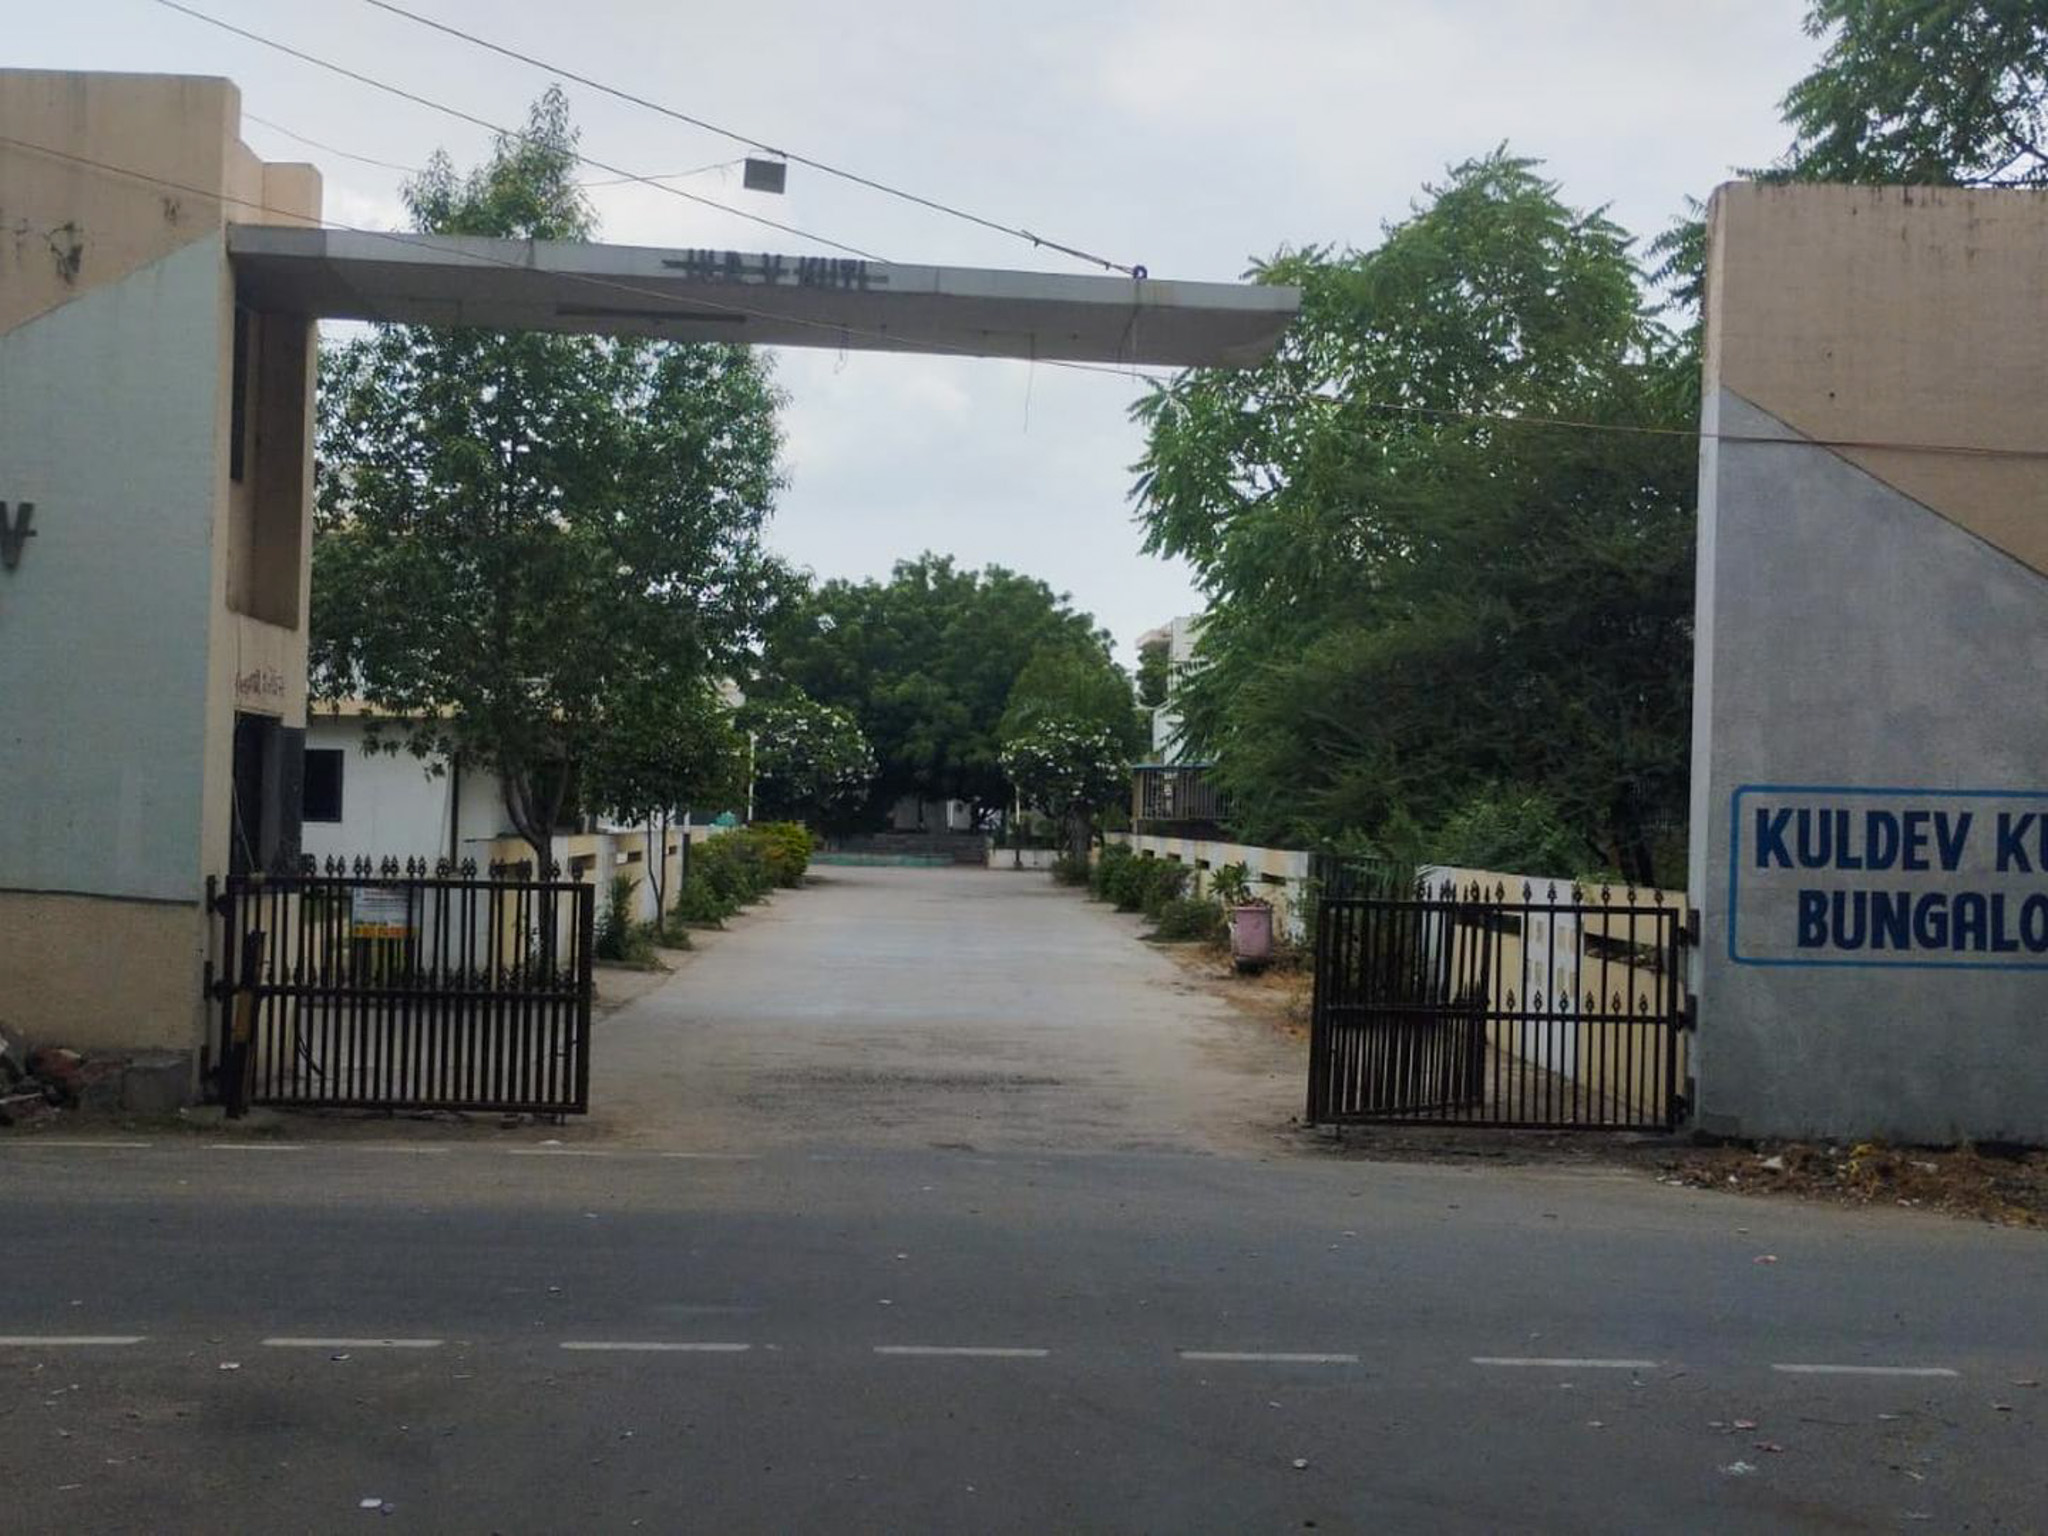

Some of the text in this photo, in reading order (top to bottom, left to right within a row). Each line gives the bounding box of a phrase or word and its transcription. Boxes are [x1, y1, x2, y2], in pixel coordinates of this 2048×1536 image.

[1755, 807, 2048, 873] KULDEV K
[1797, 889, 2048, 954] BUNGALO
